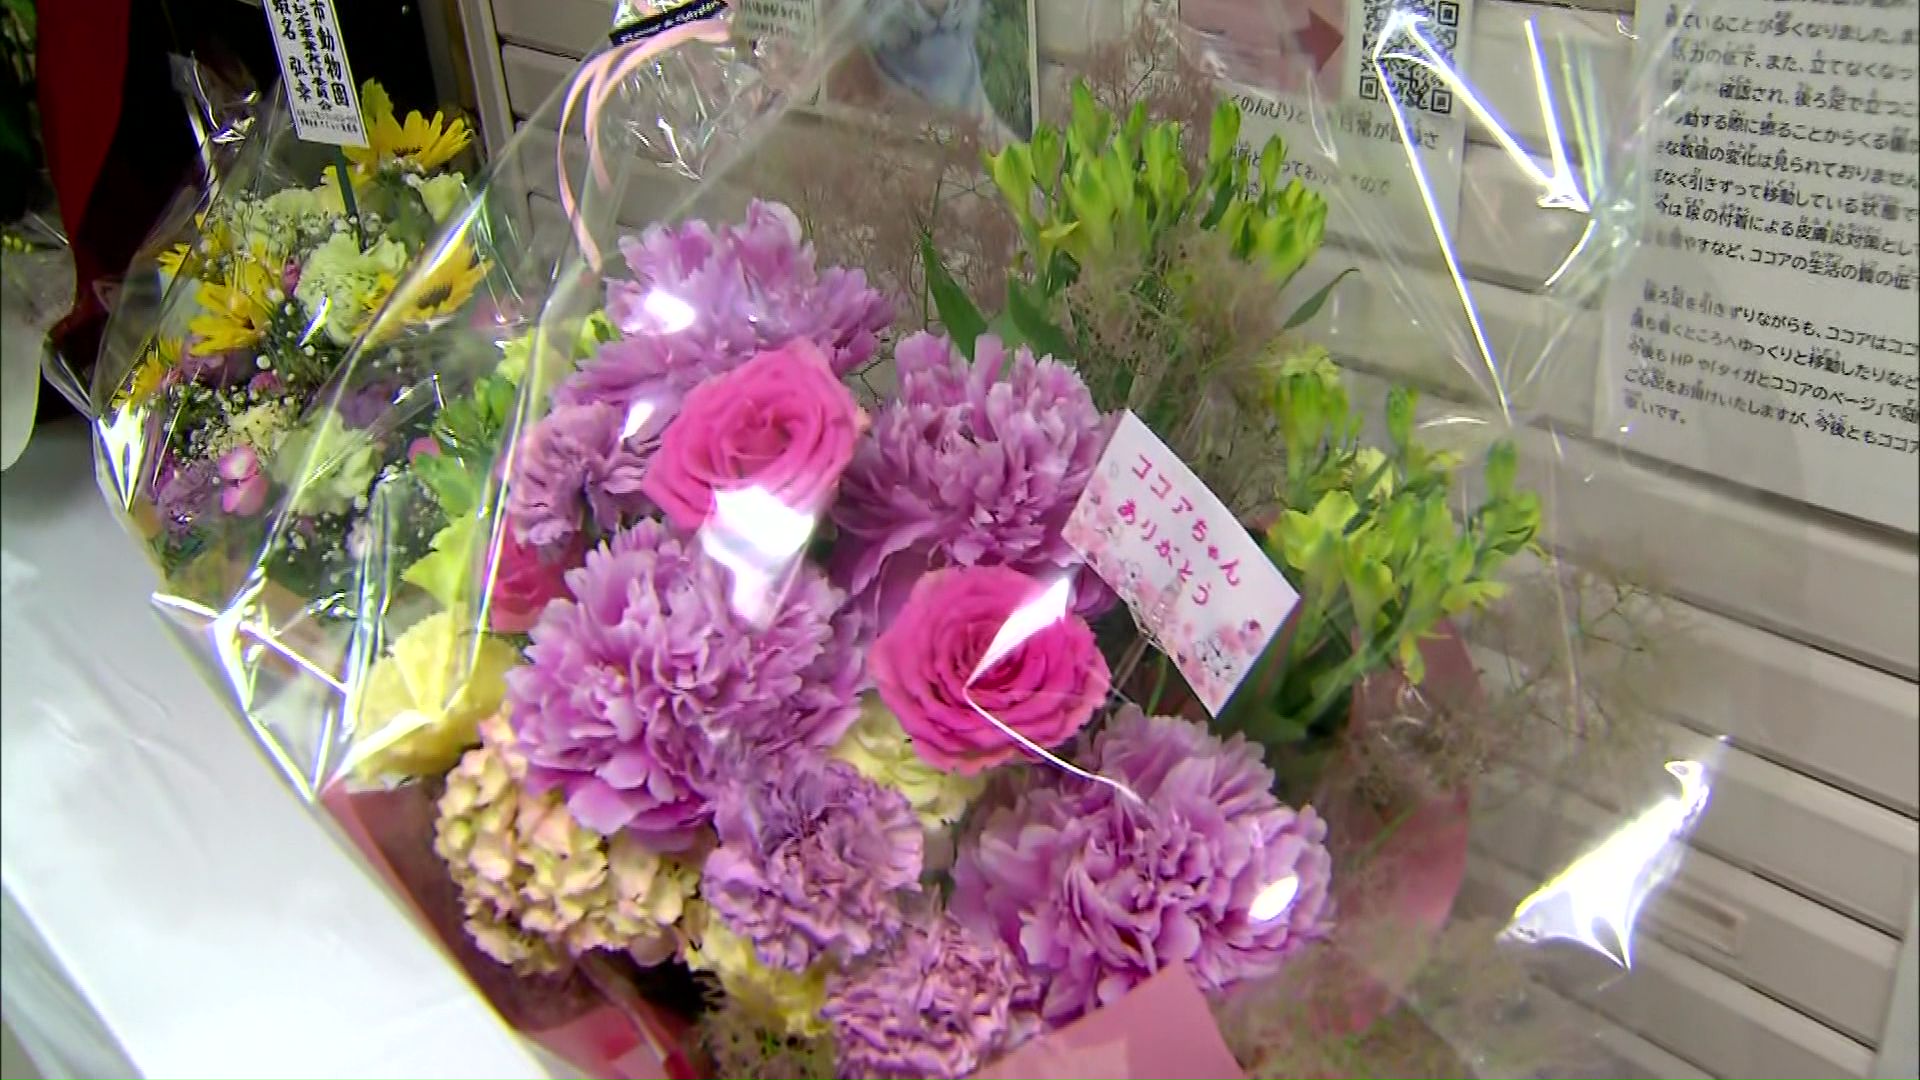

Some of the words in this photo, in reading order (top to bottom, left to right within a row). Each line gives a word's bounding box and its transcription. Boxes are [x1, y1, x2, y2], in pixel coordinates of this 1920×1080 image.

[1670, 351, 1694, 368] HP
[1117, 498, 1210, 606] ありがとう
[1131, 454, 1242, 587] ココアちゃん
